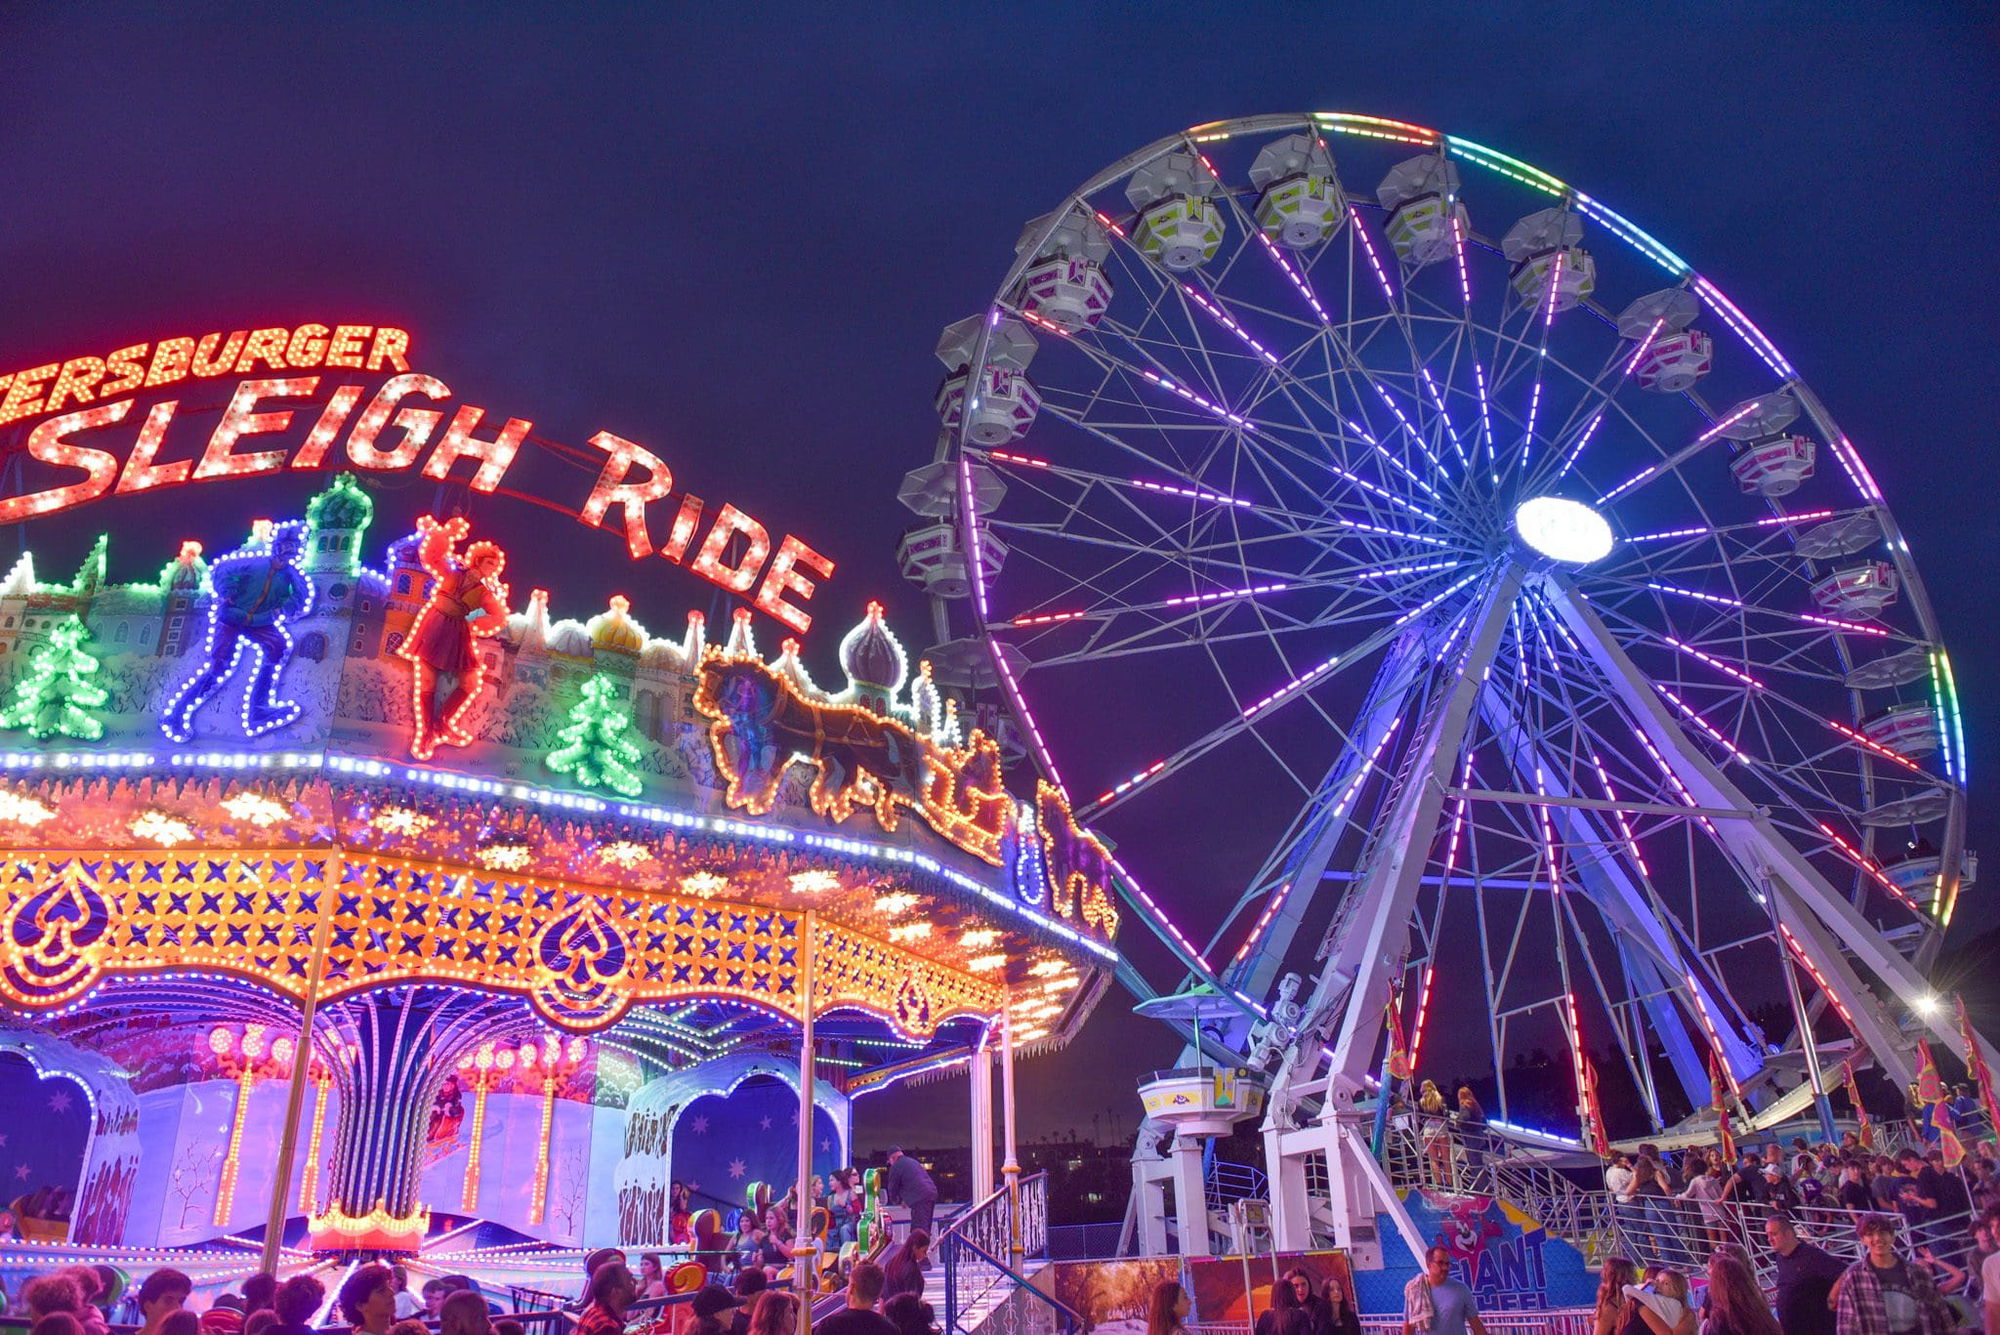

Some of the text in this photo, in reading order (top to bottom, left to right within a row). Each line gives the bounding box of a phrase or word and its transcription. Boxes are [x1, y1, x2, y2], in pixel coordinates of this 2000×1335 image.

[0, 373, 836, 635] SLEIGH RIDE
[1474, 1291, 1560, 1311] HEEL
